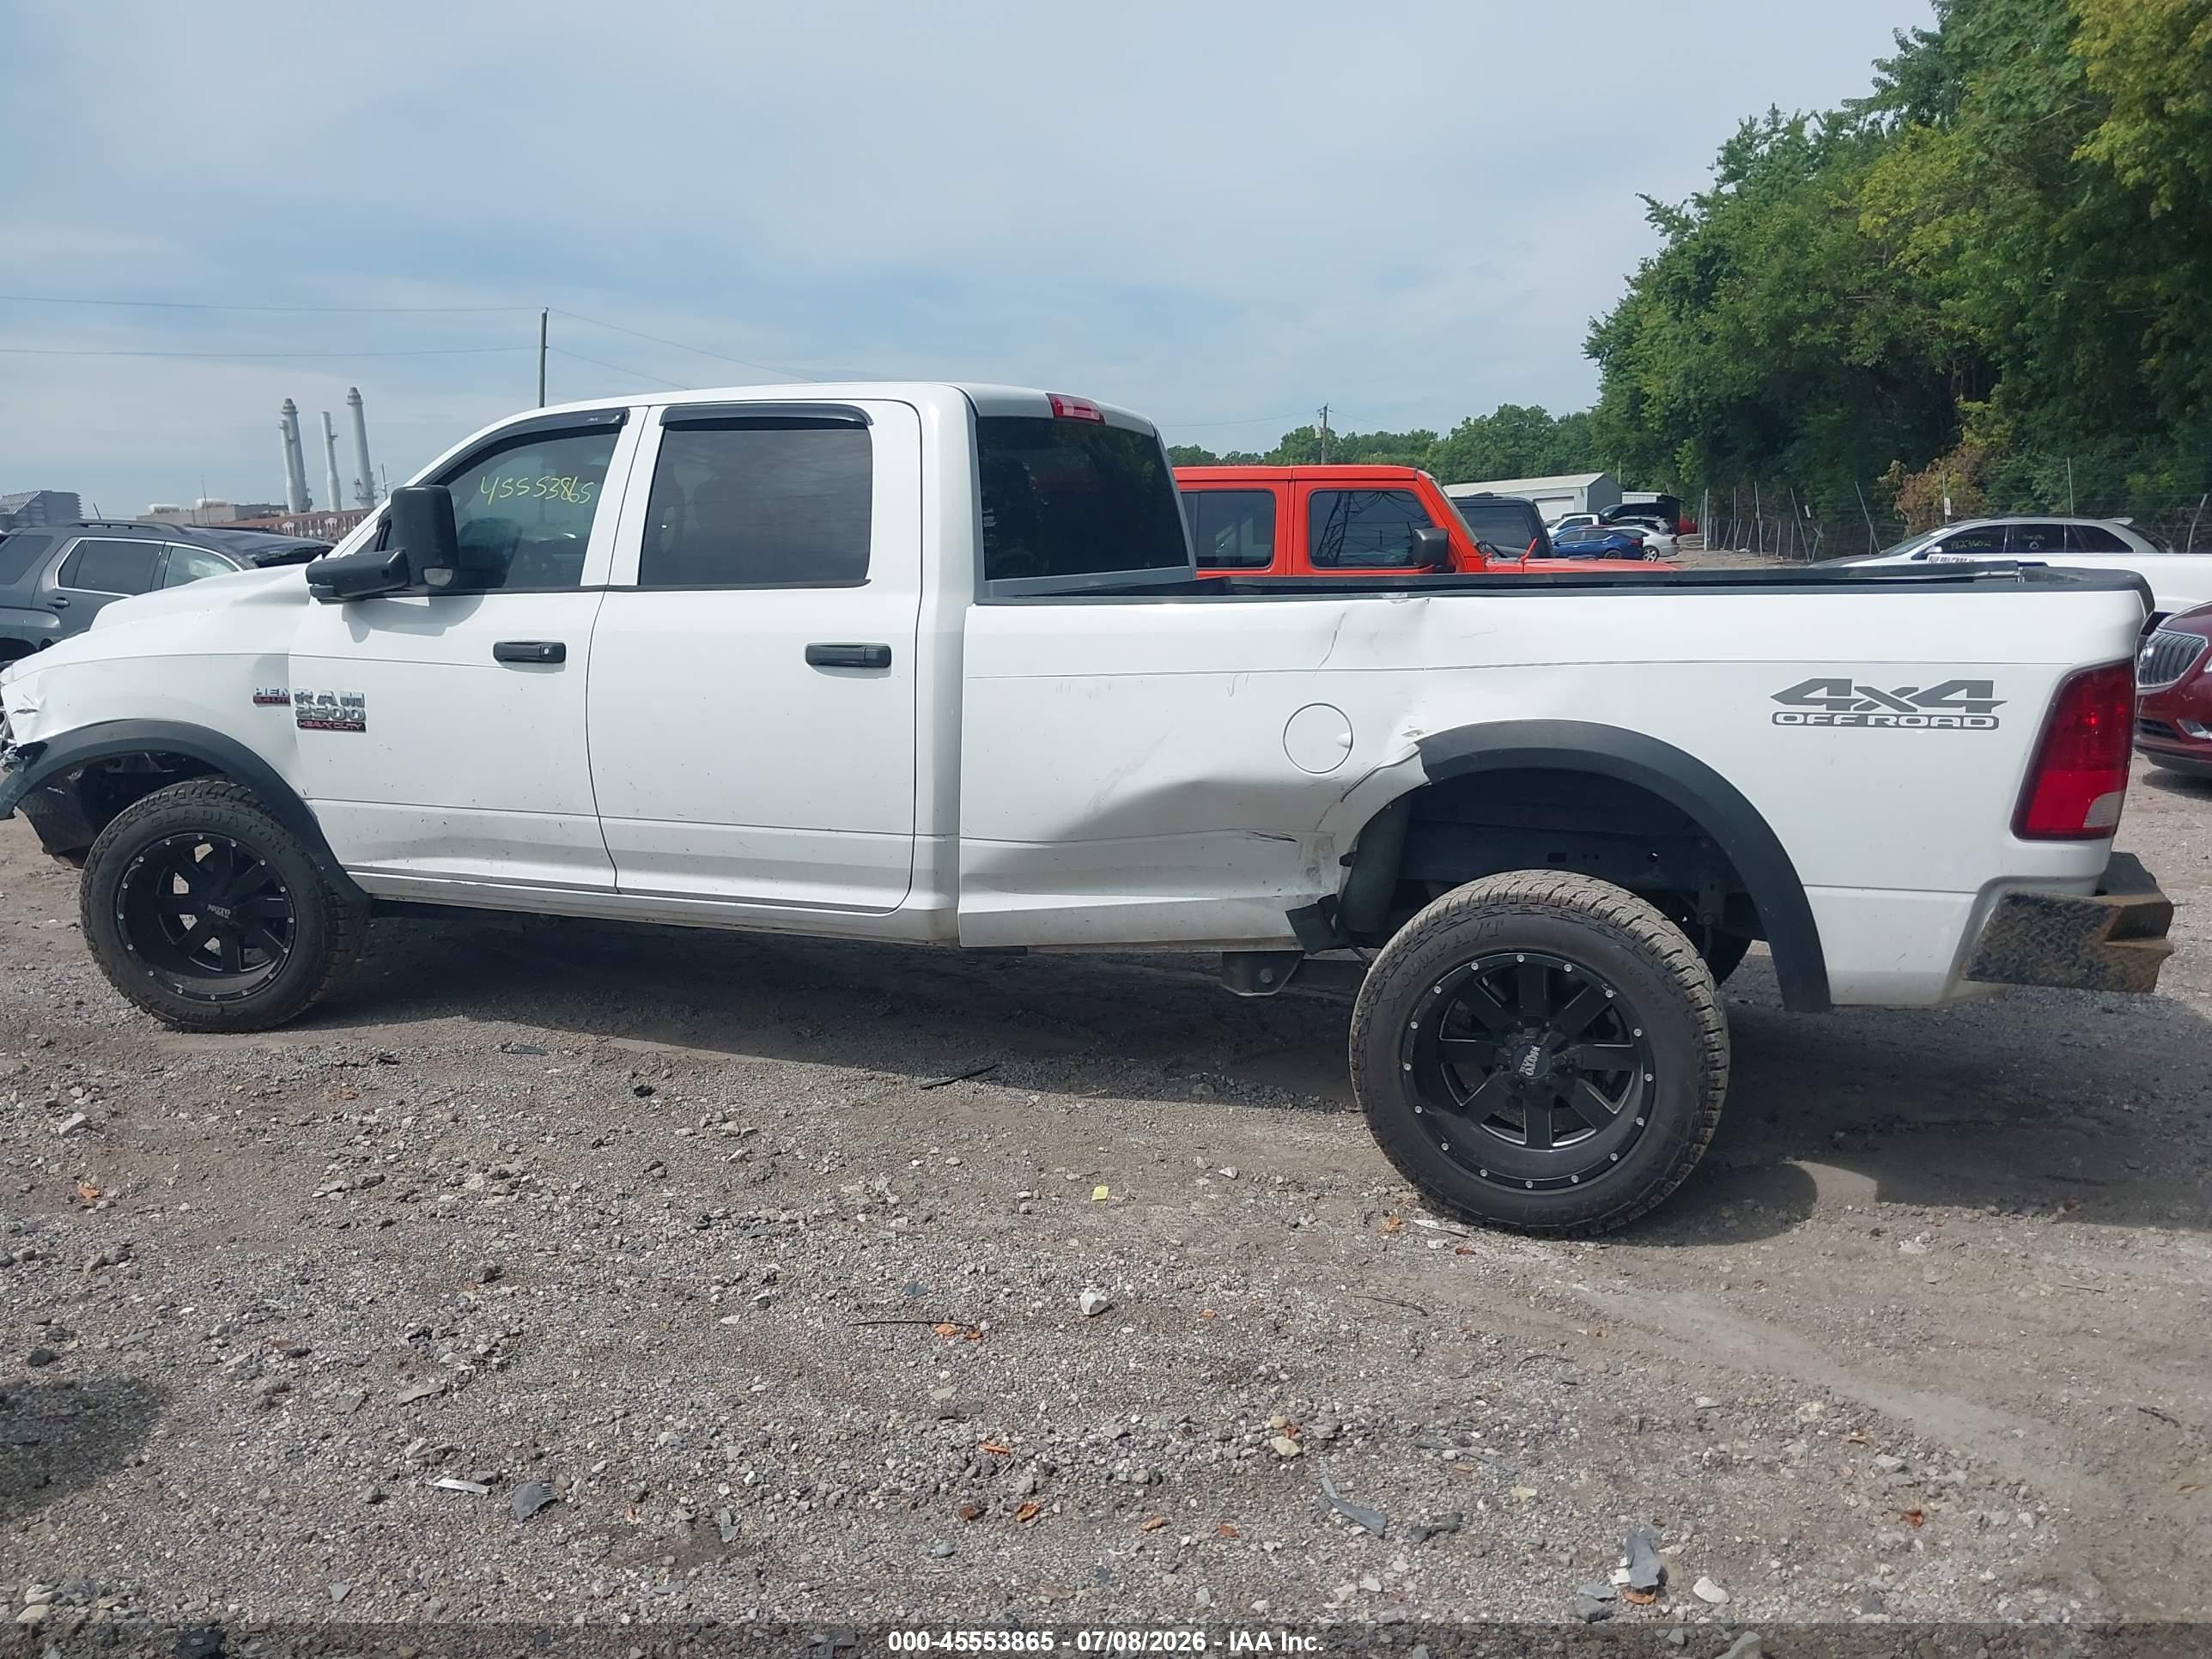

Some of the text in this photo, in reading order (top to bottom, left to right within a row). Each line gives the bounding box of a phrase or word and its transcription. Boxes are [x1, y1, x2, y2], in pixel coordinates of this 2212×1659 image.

[480, 475, 594, 505] 45553865
[294, 688, 366, 708] RAM
[295, 703, 367, 721] 2500
[1775, 713, 1995, 727] OFF ROAD
[298, 720, 362, 731] HEAVY DUTY
